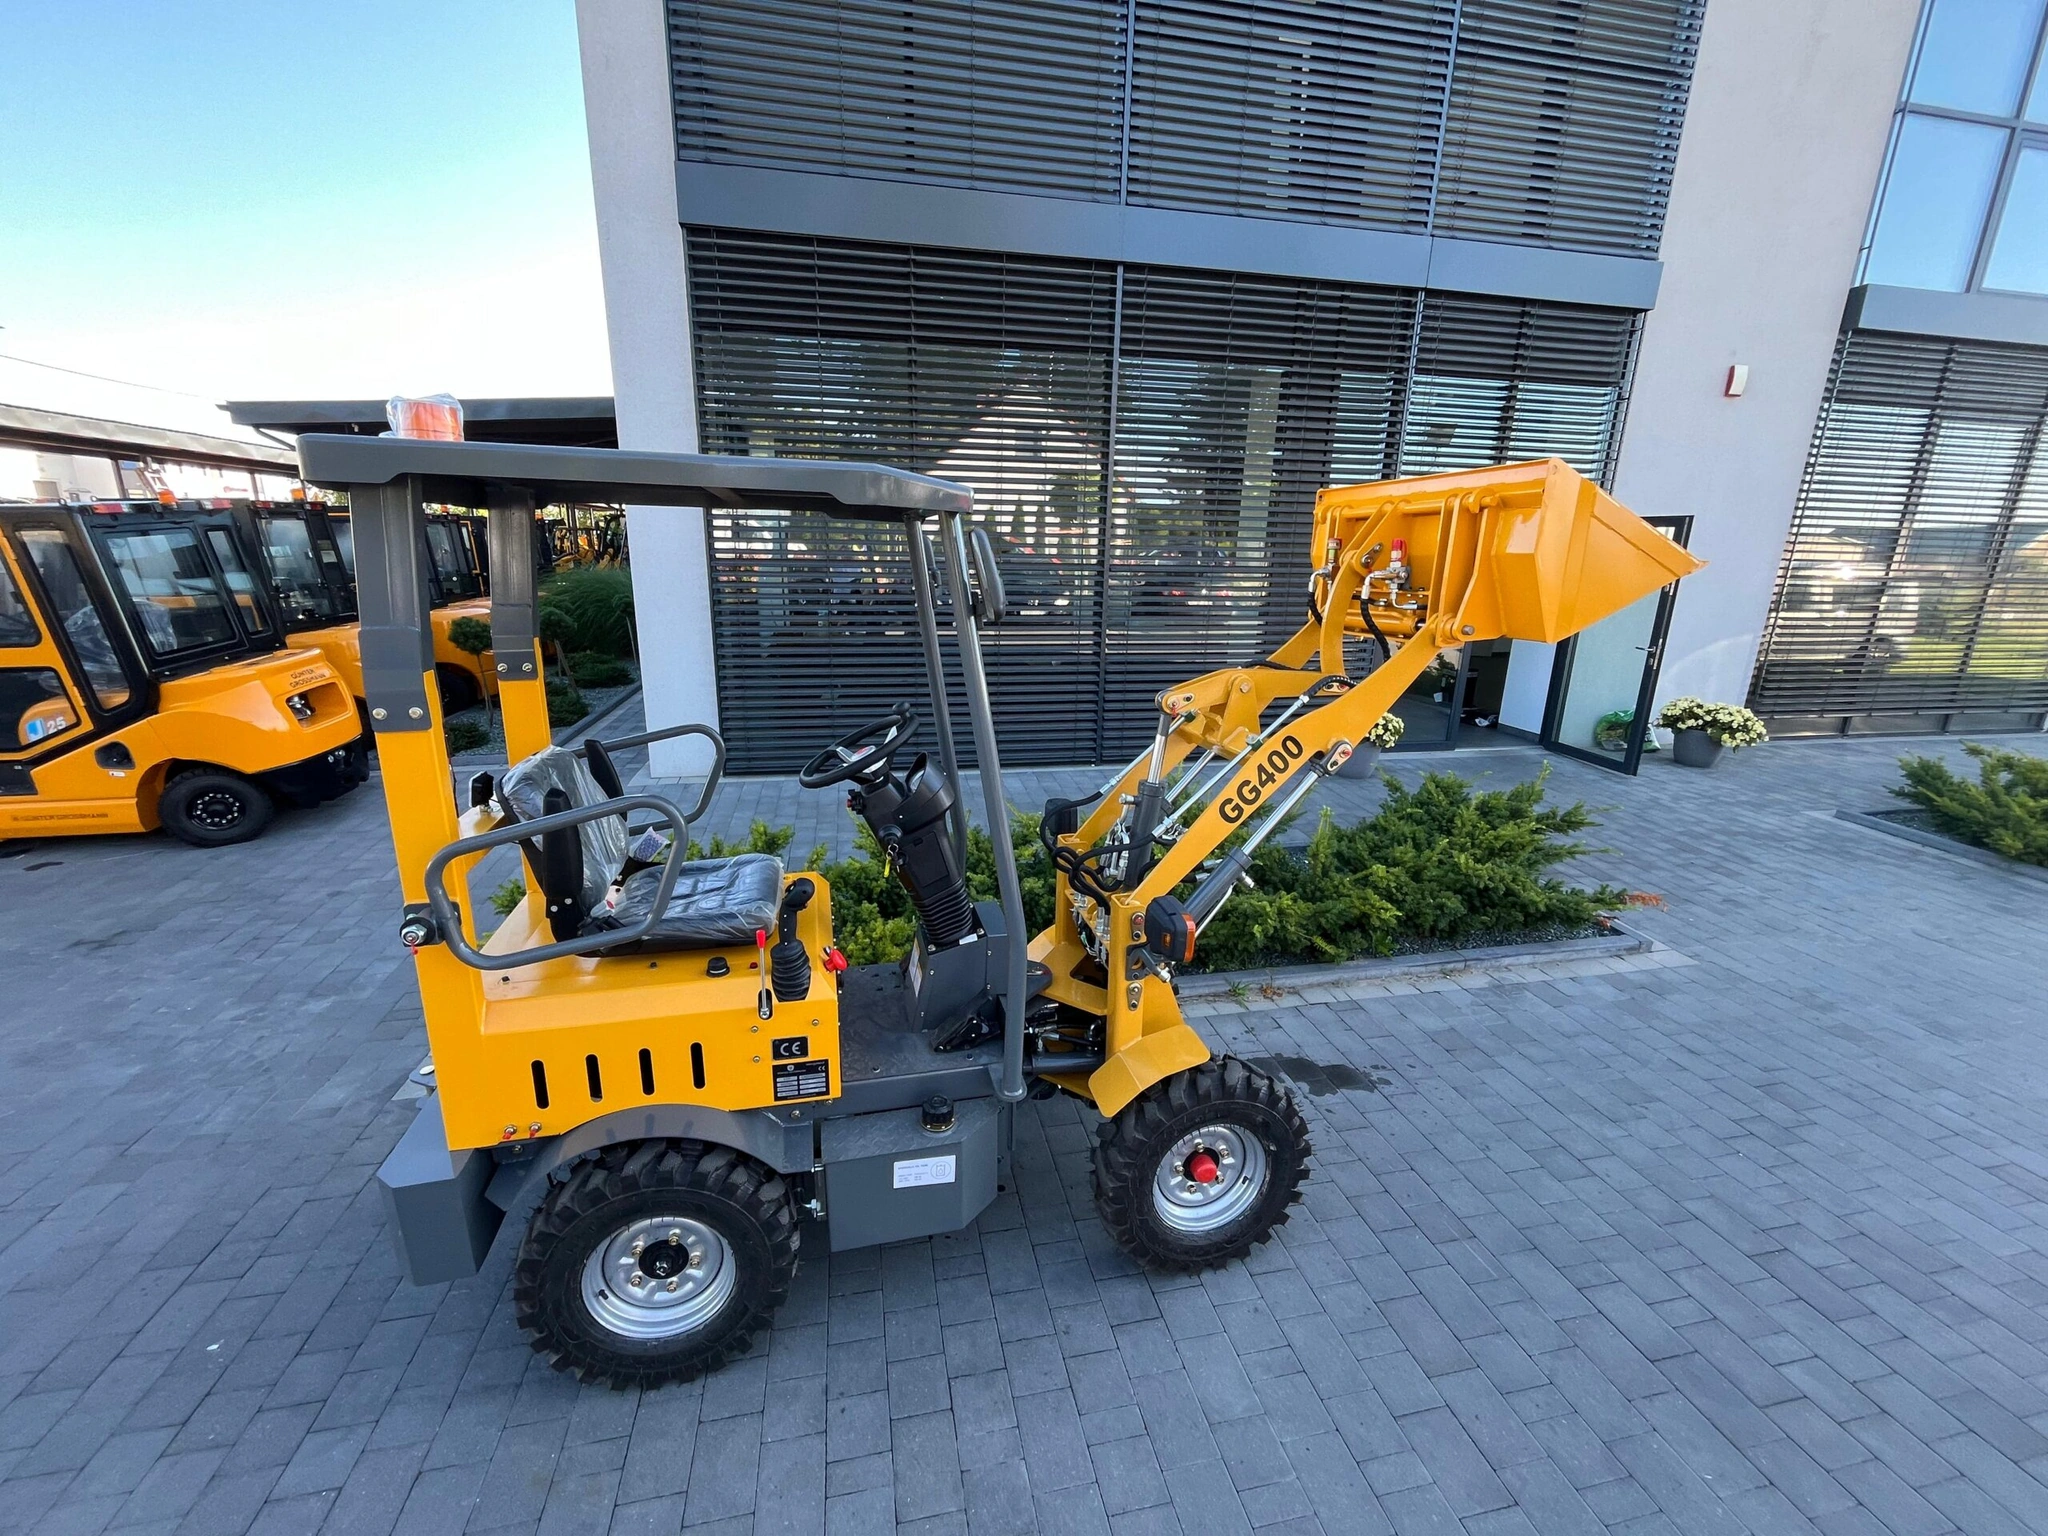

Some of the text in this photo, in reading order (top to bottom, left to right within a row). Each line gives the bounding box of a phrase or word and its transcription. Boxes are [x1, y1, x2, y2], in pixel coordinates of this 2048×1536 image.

[47, 717, 66, 734] 25
[1219, 735, 1303, 824] GG400
[780, 1041, 801, 1056] CE
